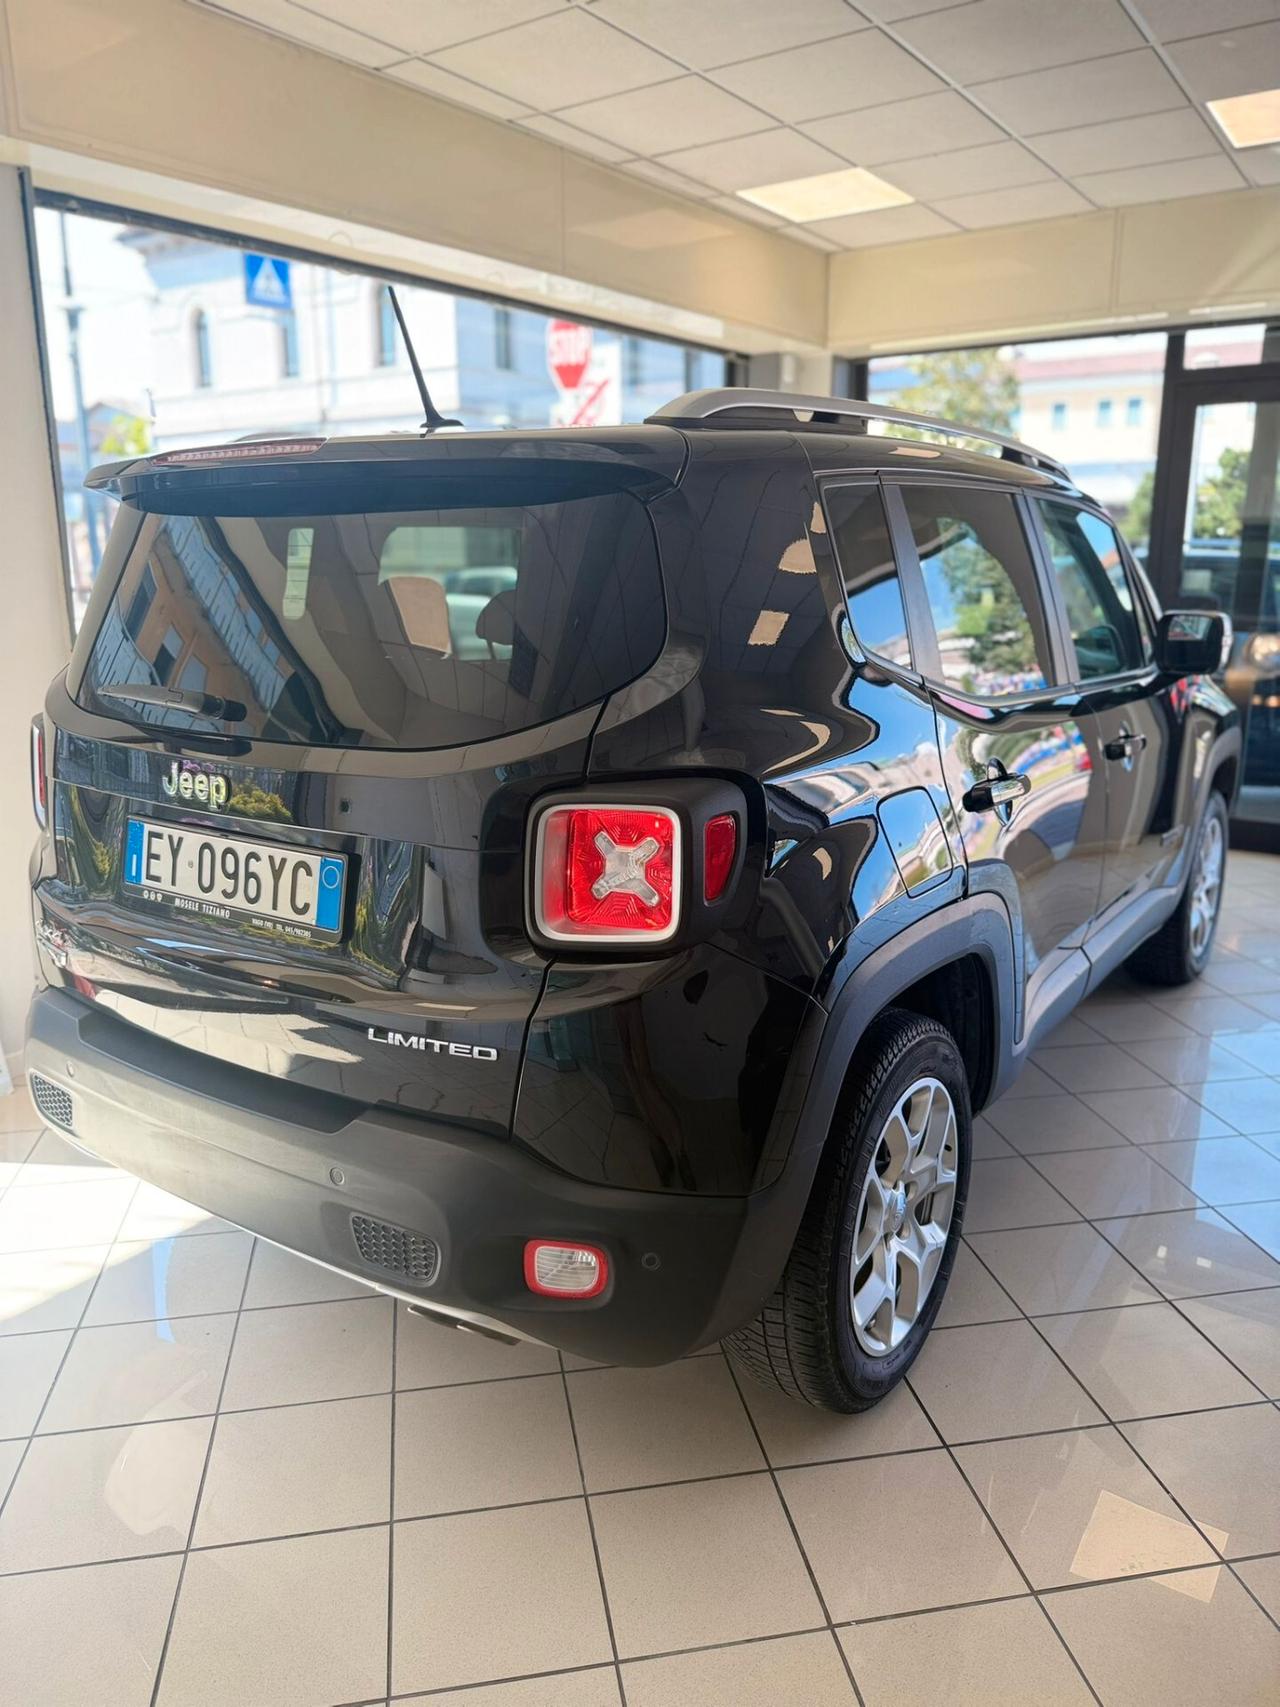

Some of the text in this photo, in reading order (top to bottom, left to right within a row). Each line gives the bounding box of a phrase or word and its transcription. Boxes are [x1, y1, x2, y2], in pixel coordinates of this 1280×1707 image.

[162, 761, 228, 808] Jeep
[146, 831, 313, 916] EY 096YC
[174, 898, 230, 918] MOSELE TIZIANO
[368, 1027, 498, 1061] LIMITED
